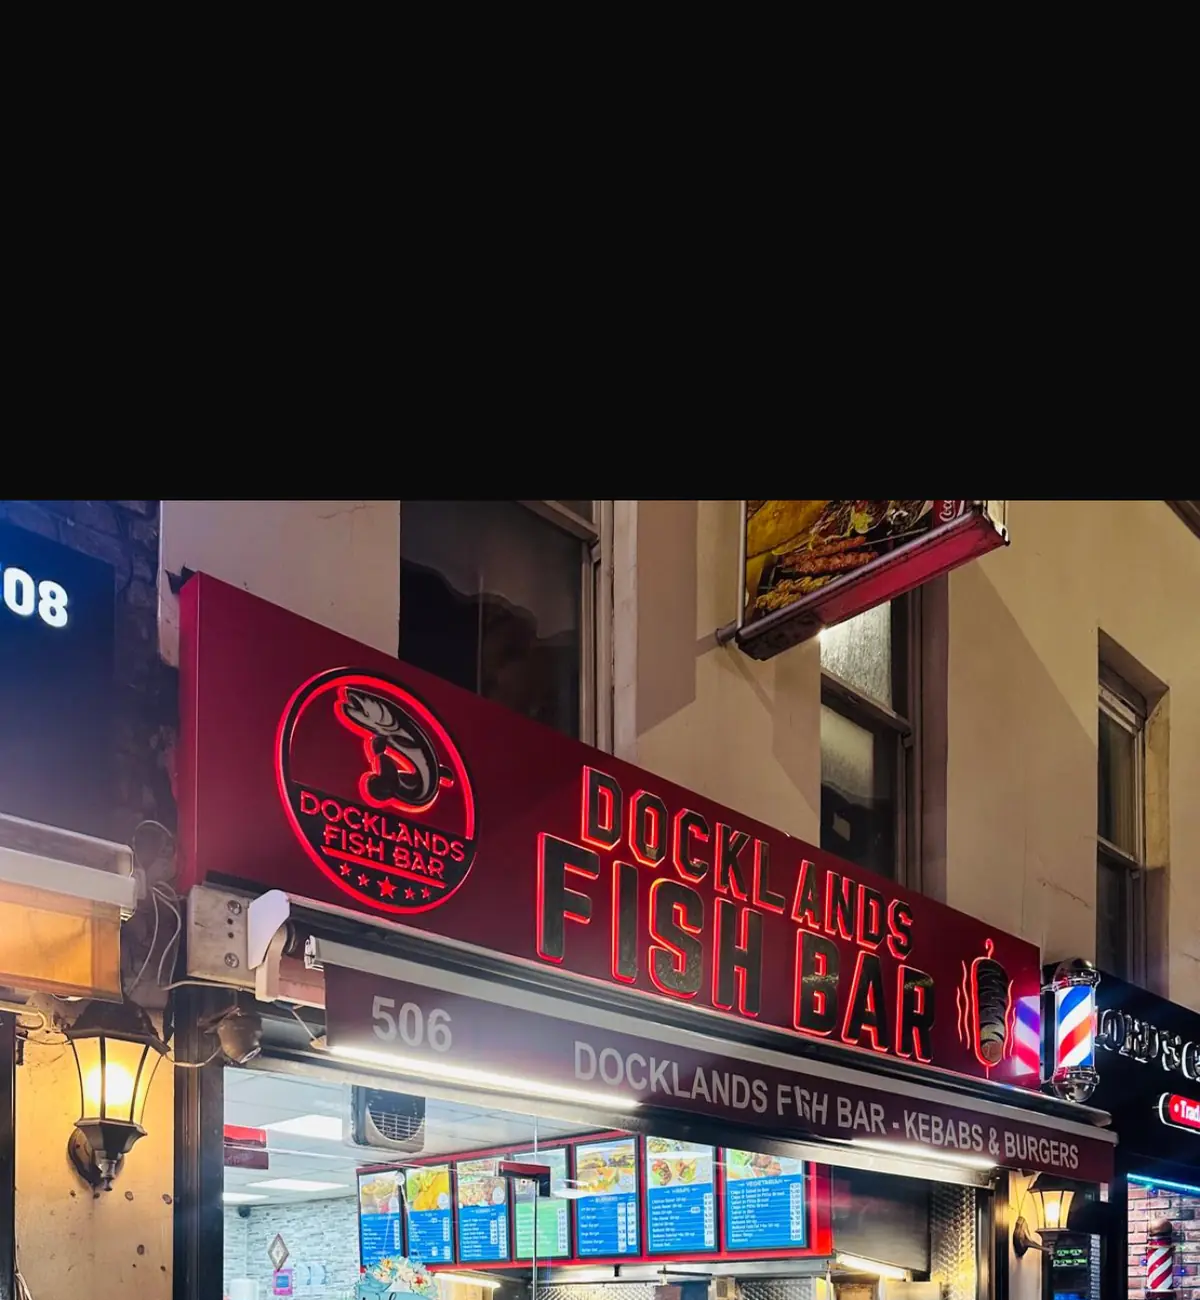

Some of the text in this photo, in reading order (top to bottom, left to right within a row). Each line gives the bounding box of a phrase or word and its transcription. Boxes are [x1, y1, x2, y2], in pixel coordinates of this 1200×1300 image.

[301, 790, 465, 862] DOCKLANDS
[323, 824, 445, 879] FISH BAR
[581, 765, 914, 961] DOCKLANDS
[537, 832, 935, 1063] FISH BAR
[372, 995, 452, 1052] 506
[574, 1040, 768, 1114] DOCKLANDS
[837, 1096, 886, 1134] BAR
[904, 1110, 983, 1152] KEBABS
[988, 1127, 1000, 1155] &
[1004, 1131, 1079, 1170] BURGERS
